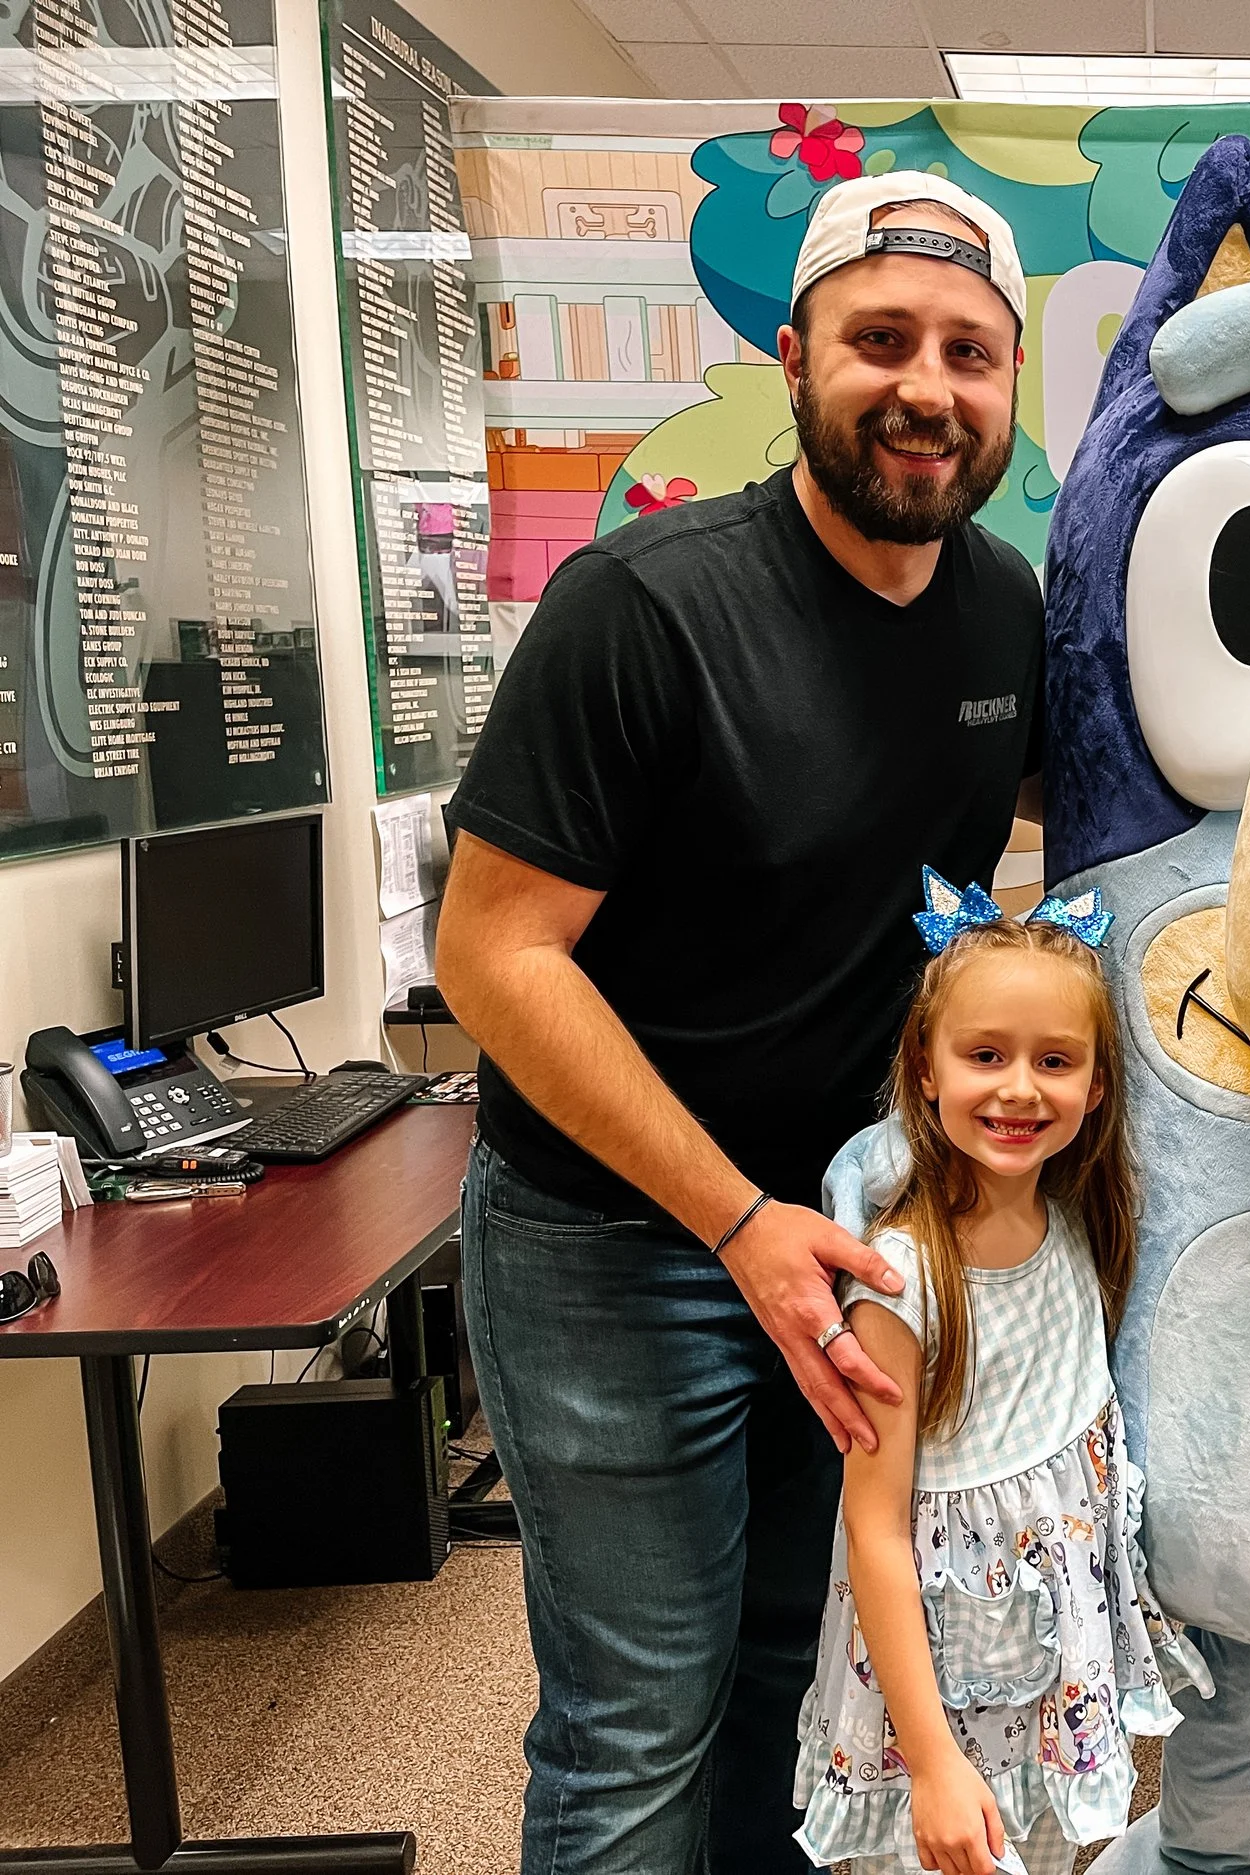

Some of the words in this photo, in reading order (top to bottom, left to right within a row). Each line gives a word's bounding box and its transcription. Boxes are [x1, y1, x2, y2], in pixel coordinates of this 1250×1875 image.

[49, 229, 69, 246] STEVE
[83, 274, 110, 293] ATLANTIC
[97, 294, 116, 310] GROUP
[78, 319, 104, 337] PACKING
[97, 310, 110, 323] AND
[111, 315, 138, 332] COMPANY
[85, 339, 117, 356] FURNITURE
[59, 347, 94, 365] DAVENPORT
[60, 363, 78, 377] DAVIS
[106, 375, 118, 387] AND
[118, 378, 143, 394] WELDING
[82, 401, 122, 419] MANAGEMENT
[101, 421, 113, 433] LAW
[114, 423, 133, 436] GROUP
[75, 433, 98, 445] GRIFFIN
[67, 446, 83, 459] ROCK
[114, 471, 127, 482] PLLC
[84, 481, 102, 493] SMITH
[70, 495, 106, 510] DONALDSON
[108, 501, 120, 512] AND
[121, 502, 139, 514] BLACK
[105, 516, 138, 529] PROPERTIES
[91, 529, 118, 543] ANTHONY
[74, 544, 100, 557] RICHARD
[102, 547, 114, 558] AND
[115, 549, 131, 559] JOAN
[90, 561, 105, 573] DOSS
[77, 577, 98, 588] RANDY
[99, 578, 114, 589] DOSS
[79, 593, 93, 604] DOW
[94, 594, 120, 605] CORNING
[80, 609, 94, 620] TOM
[95, 609, 108, 620] AND
[123, 611, 146, 621] DUNCAN
[89, 625, 108, 635] STONE
[108, 626, 135, 636] BUILDERS
[83, 641, 101, 651] EANES
[102, 642, 122, 651] GROUP
[97, 657, 117, 667] SUPPLY
[85, 673, 114, 683] ECOLOGIC
[87, 689, 98, 699] ELC
[98, 688, 140, 699] INVESTIGATIVE
[88, 704, 115, 715] ELECTRIC
[116, 703, 135, 713] SUPPLY
[137, 702, 149, 712] AND
[150, 701, 180, 712] EQUIPMENT
[958, 694, 1016, 722] BUCKNER
[90, 720, 102, 730] WES
[91, 736, 107, 746] ELITE
[108, 735, 125, 745] HOME
[126, 732, 156, 744] MORTGAGE
[93, 752, 105, 762] ELM
[106, 750, 125, 761] STREET
[127, 749, 140, 759] TIRE
[94, 767, 113, 778] BRIAN
[114, 764, 139, 776] ENRIGHT
